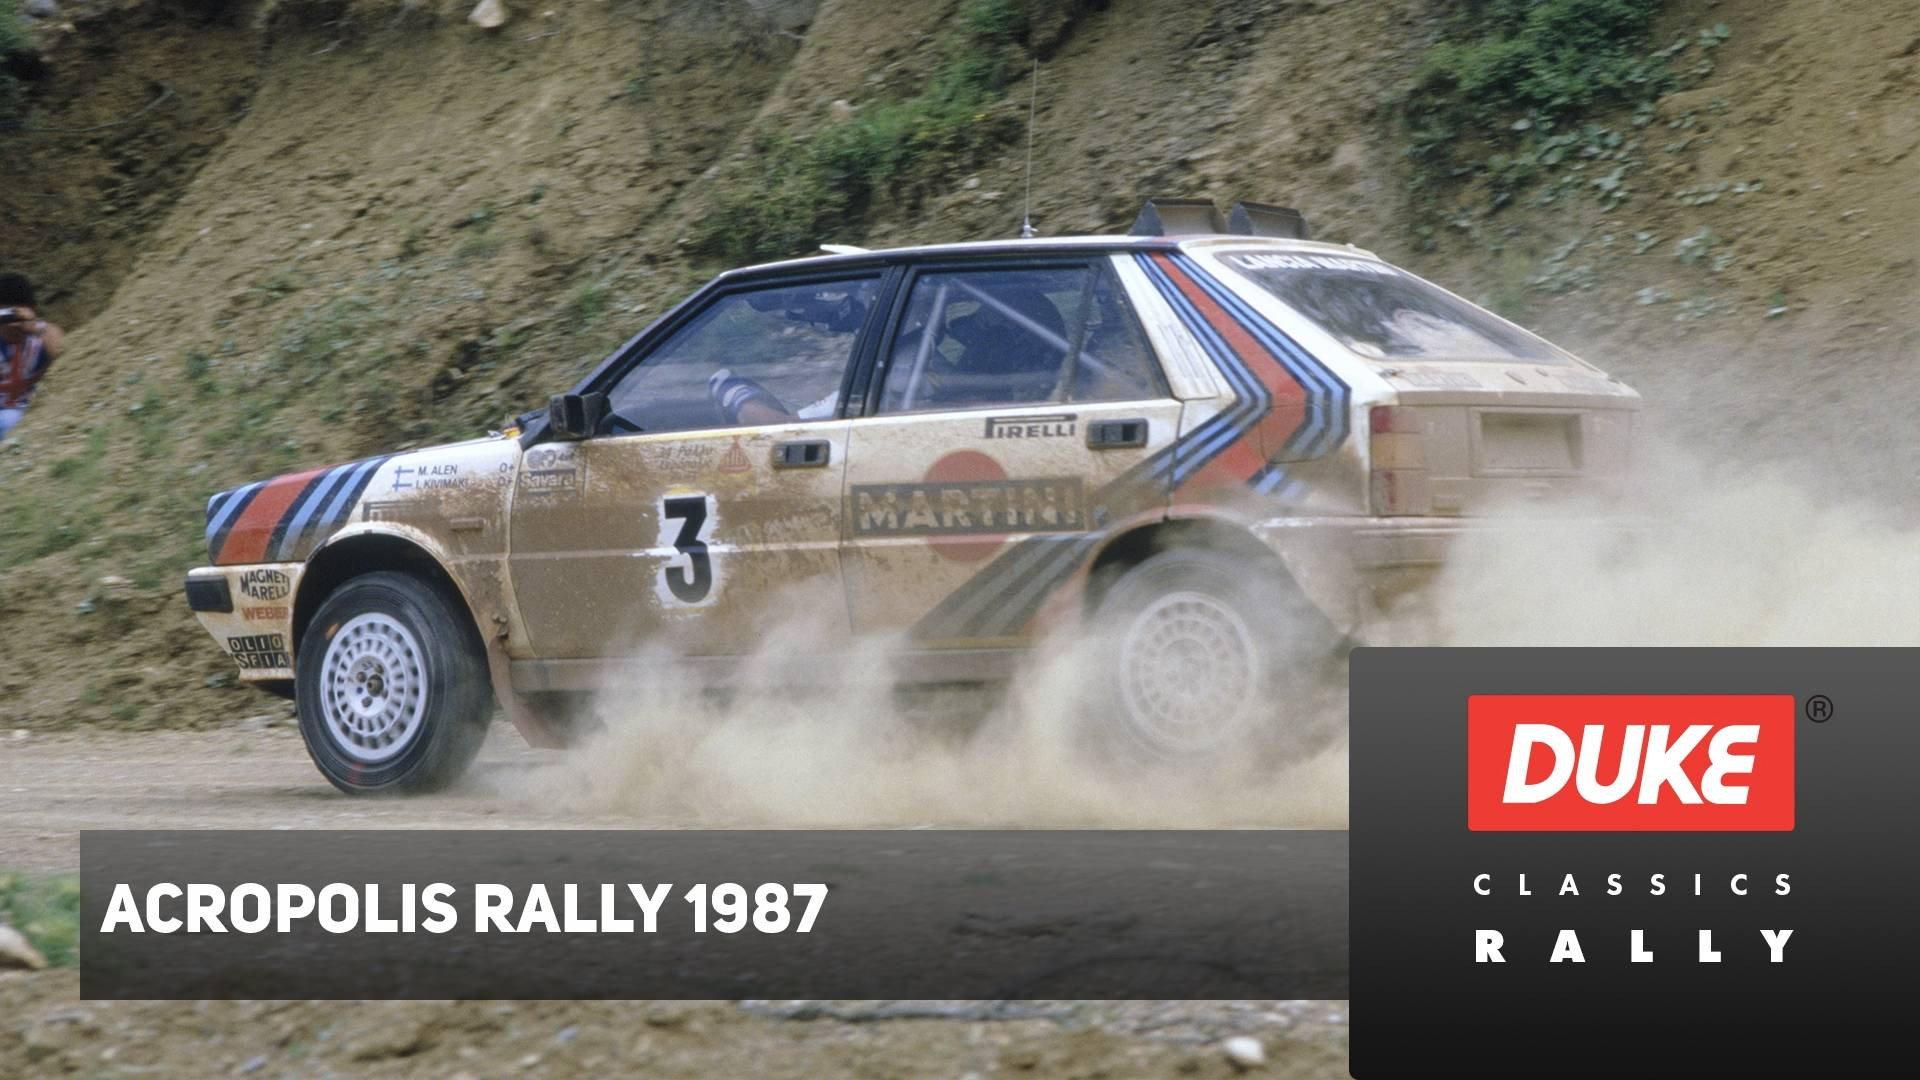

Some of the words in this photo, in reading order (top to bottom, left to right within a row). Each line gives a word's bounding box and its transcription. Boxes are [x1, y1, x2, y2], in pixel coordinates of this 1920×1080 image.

[985, 413, 1078, 439] PIRELLI
[431, 464, 458, 475] ALEN
[858, 487, 1077, 530] MARTINI
[663, 496, 712, 603] 3
[229, 636, 283, 651] OLIO
